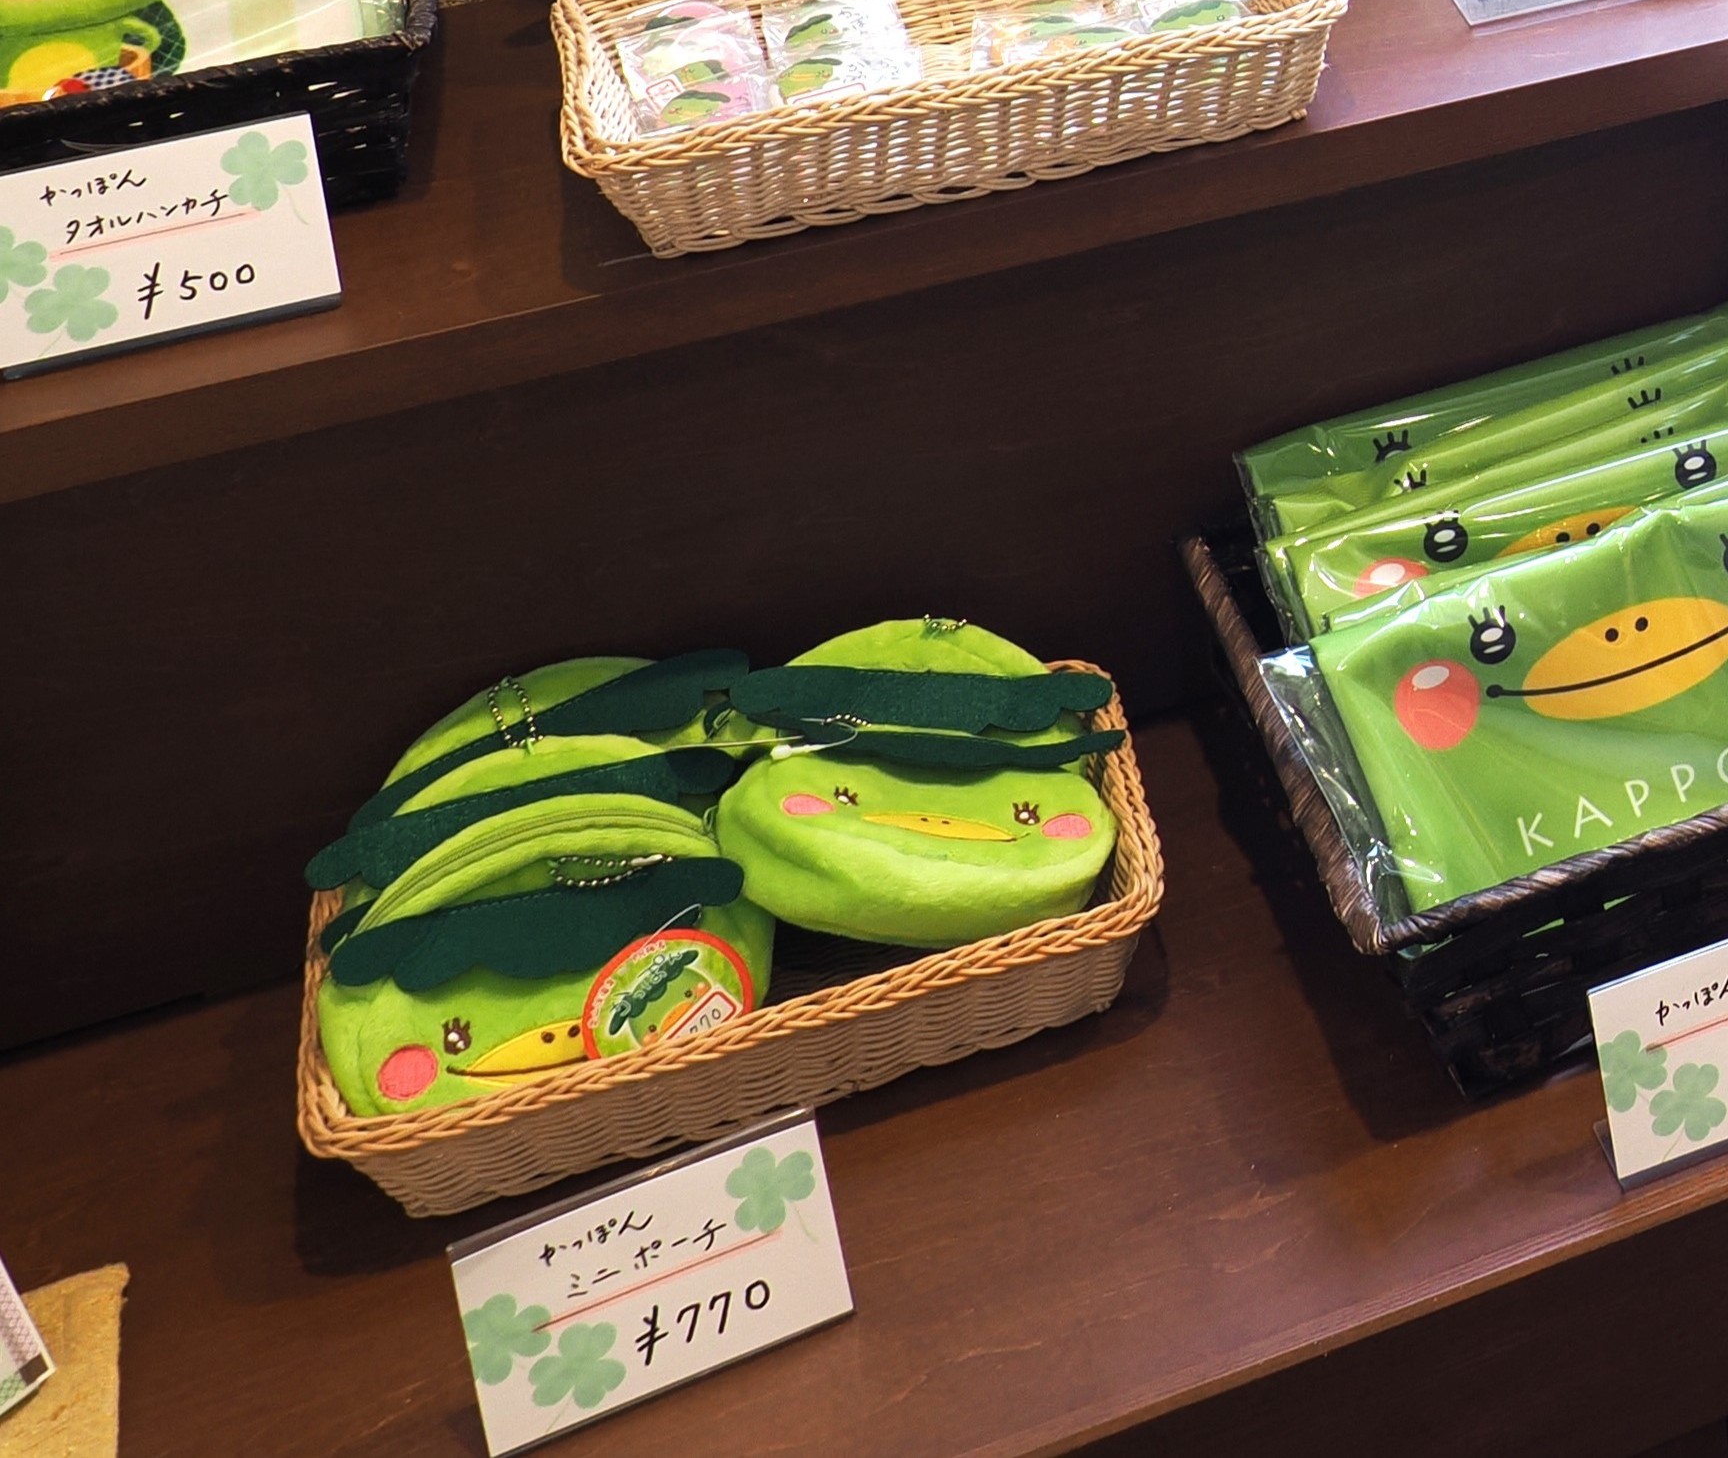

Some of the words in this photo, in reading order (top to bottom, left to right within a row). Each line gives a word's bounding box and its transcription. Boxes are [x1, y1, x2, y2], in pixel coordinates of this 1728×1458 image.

[38, 167, 147, 206] かっぽん
[64, 187, 231, 243] タオルハンカチ
[137, 262, 255, 320] ¥500
[537, 1208, 654, 1269] かっぽん
[565, 1220, 729, 1300] ミニポーチ
[634, 1278, 772, 1366] ¥770
